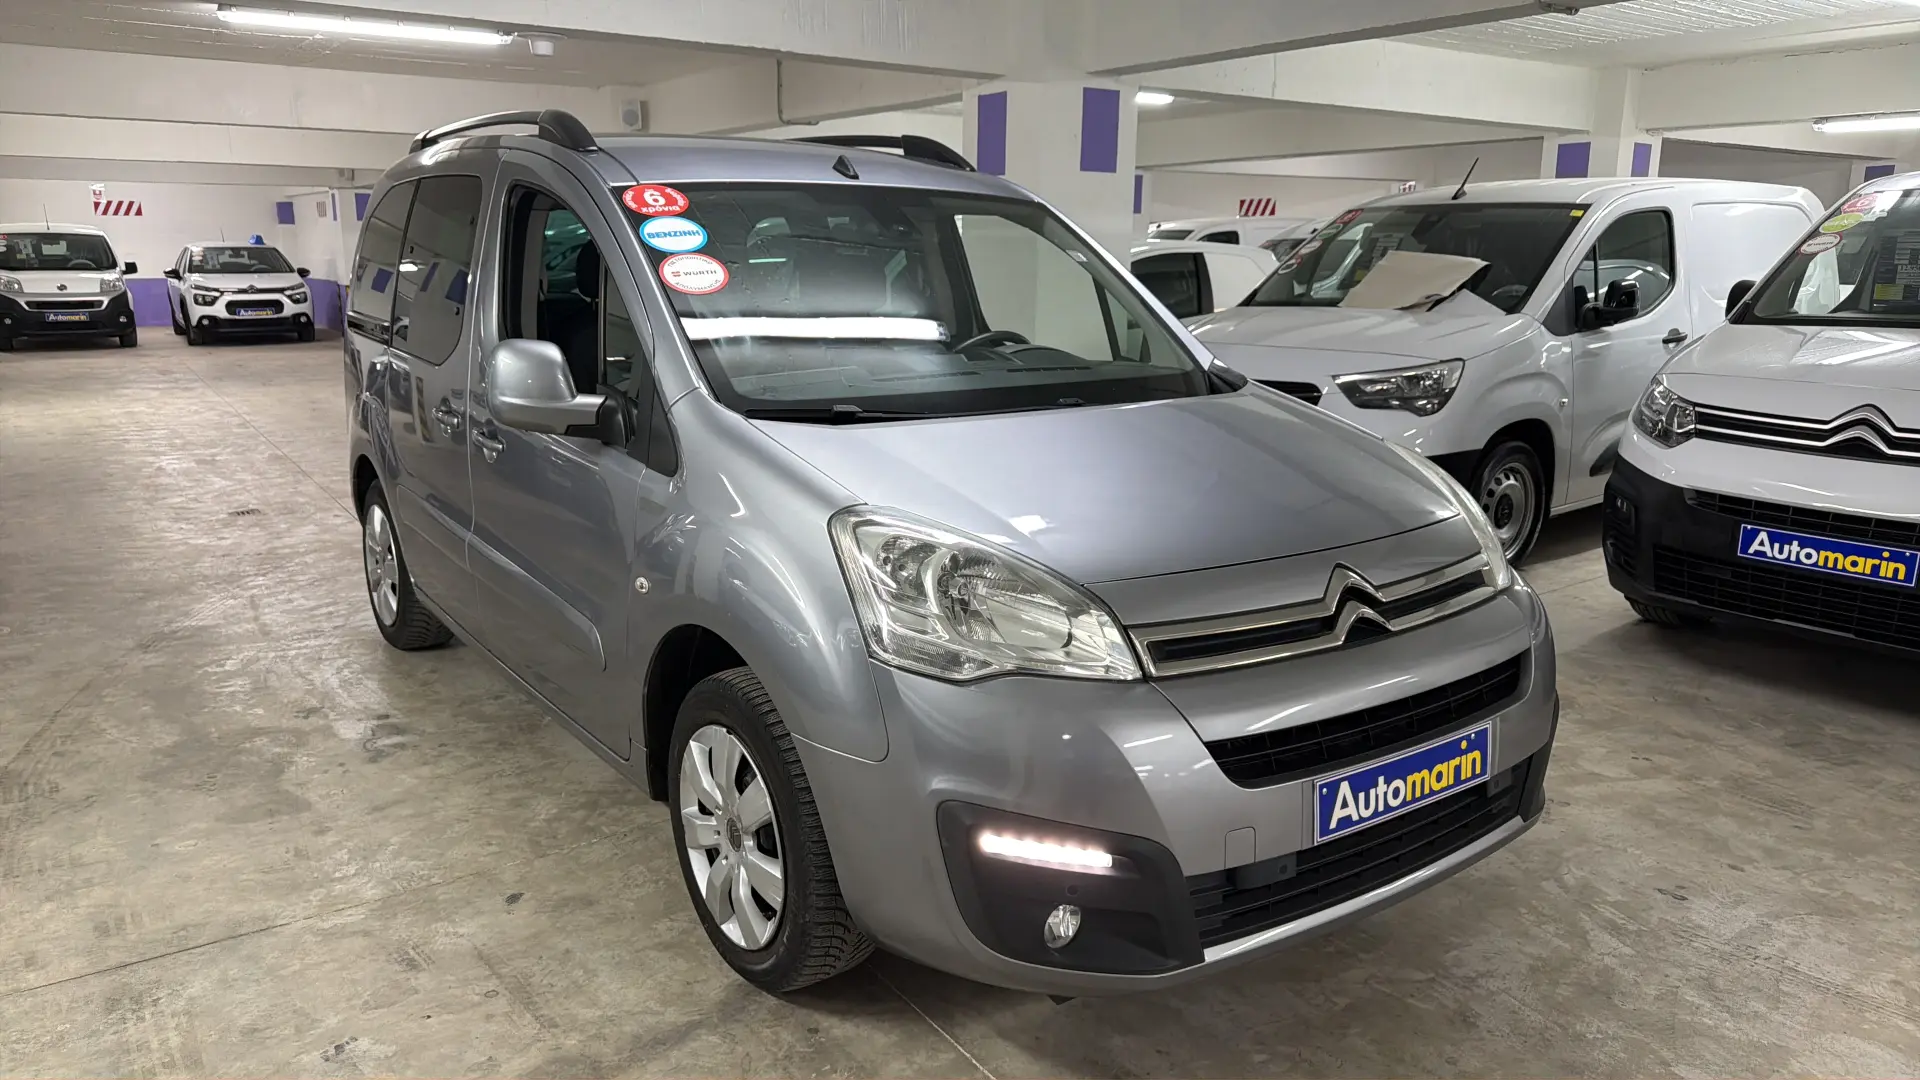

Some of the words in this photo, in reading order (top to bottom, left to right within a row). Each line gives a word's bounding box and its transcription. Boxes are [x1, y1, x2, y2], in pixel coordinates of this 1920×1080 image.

[643, 190, 666, 206] 6
[641, 204, 681, 213] χρόνια
[646, 229, 701, 239] ΒΕΝΖΙΝΗ
[49, 312, 87, 321] Automarin
[239, 308, 273, 316] Automarin
[1747, 531, 1907, 580] Automarin
[1329, 740, 1481, 830] Automarin
